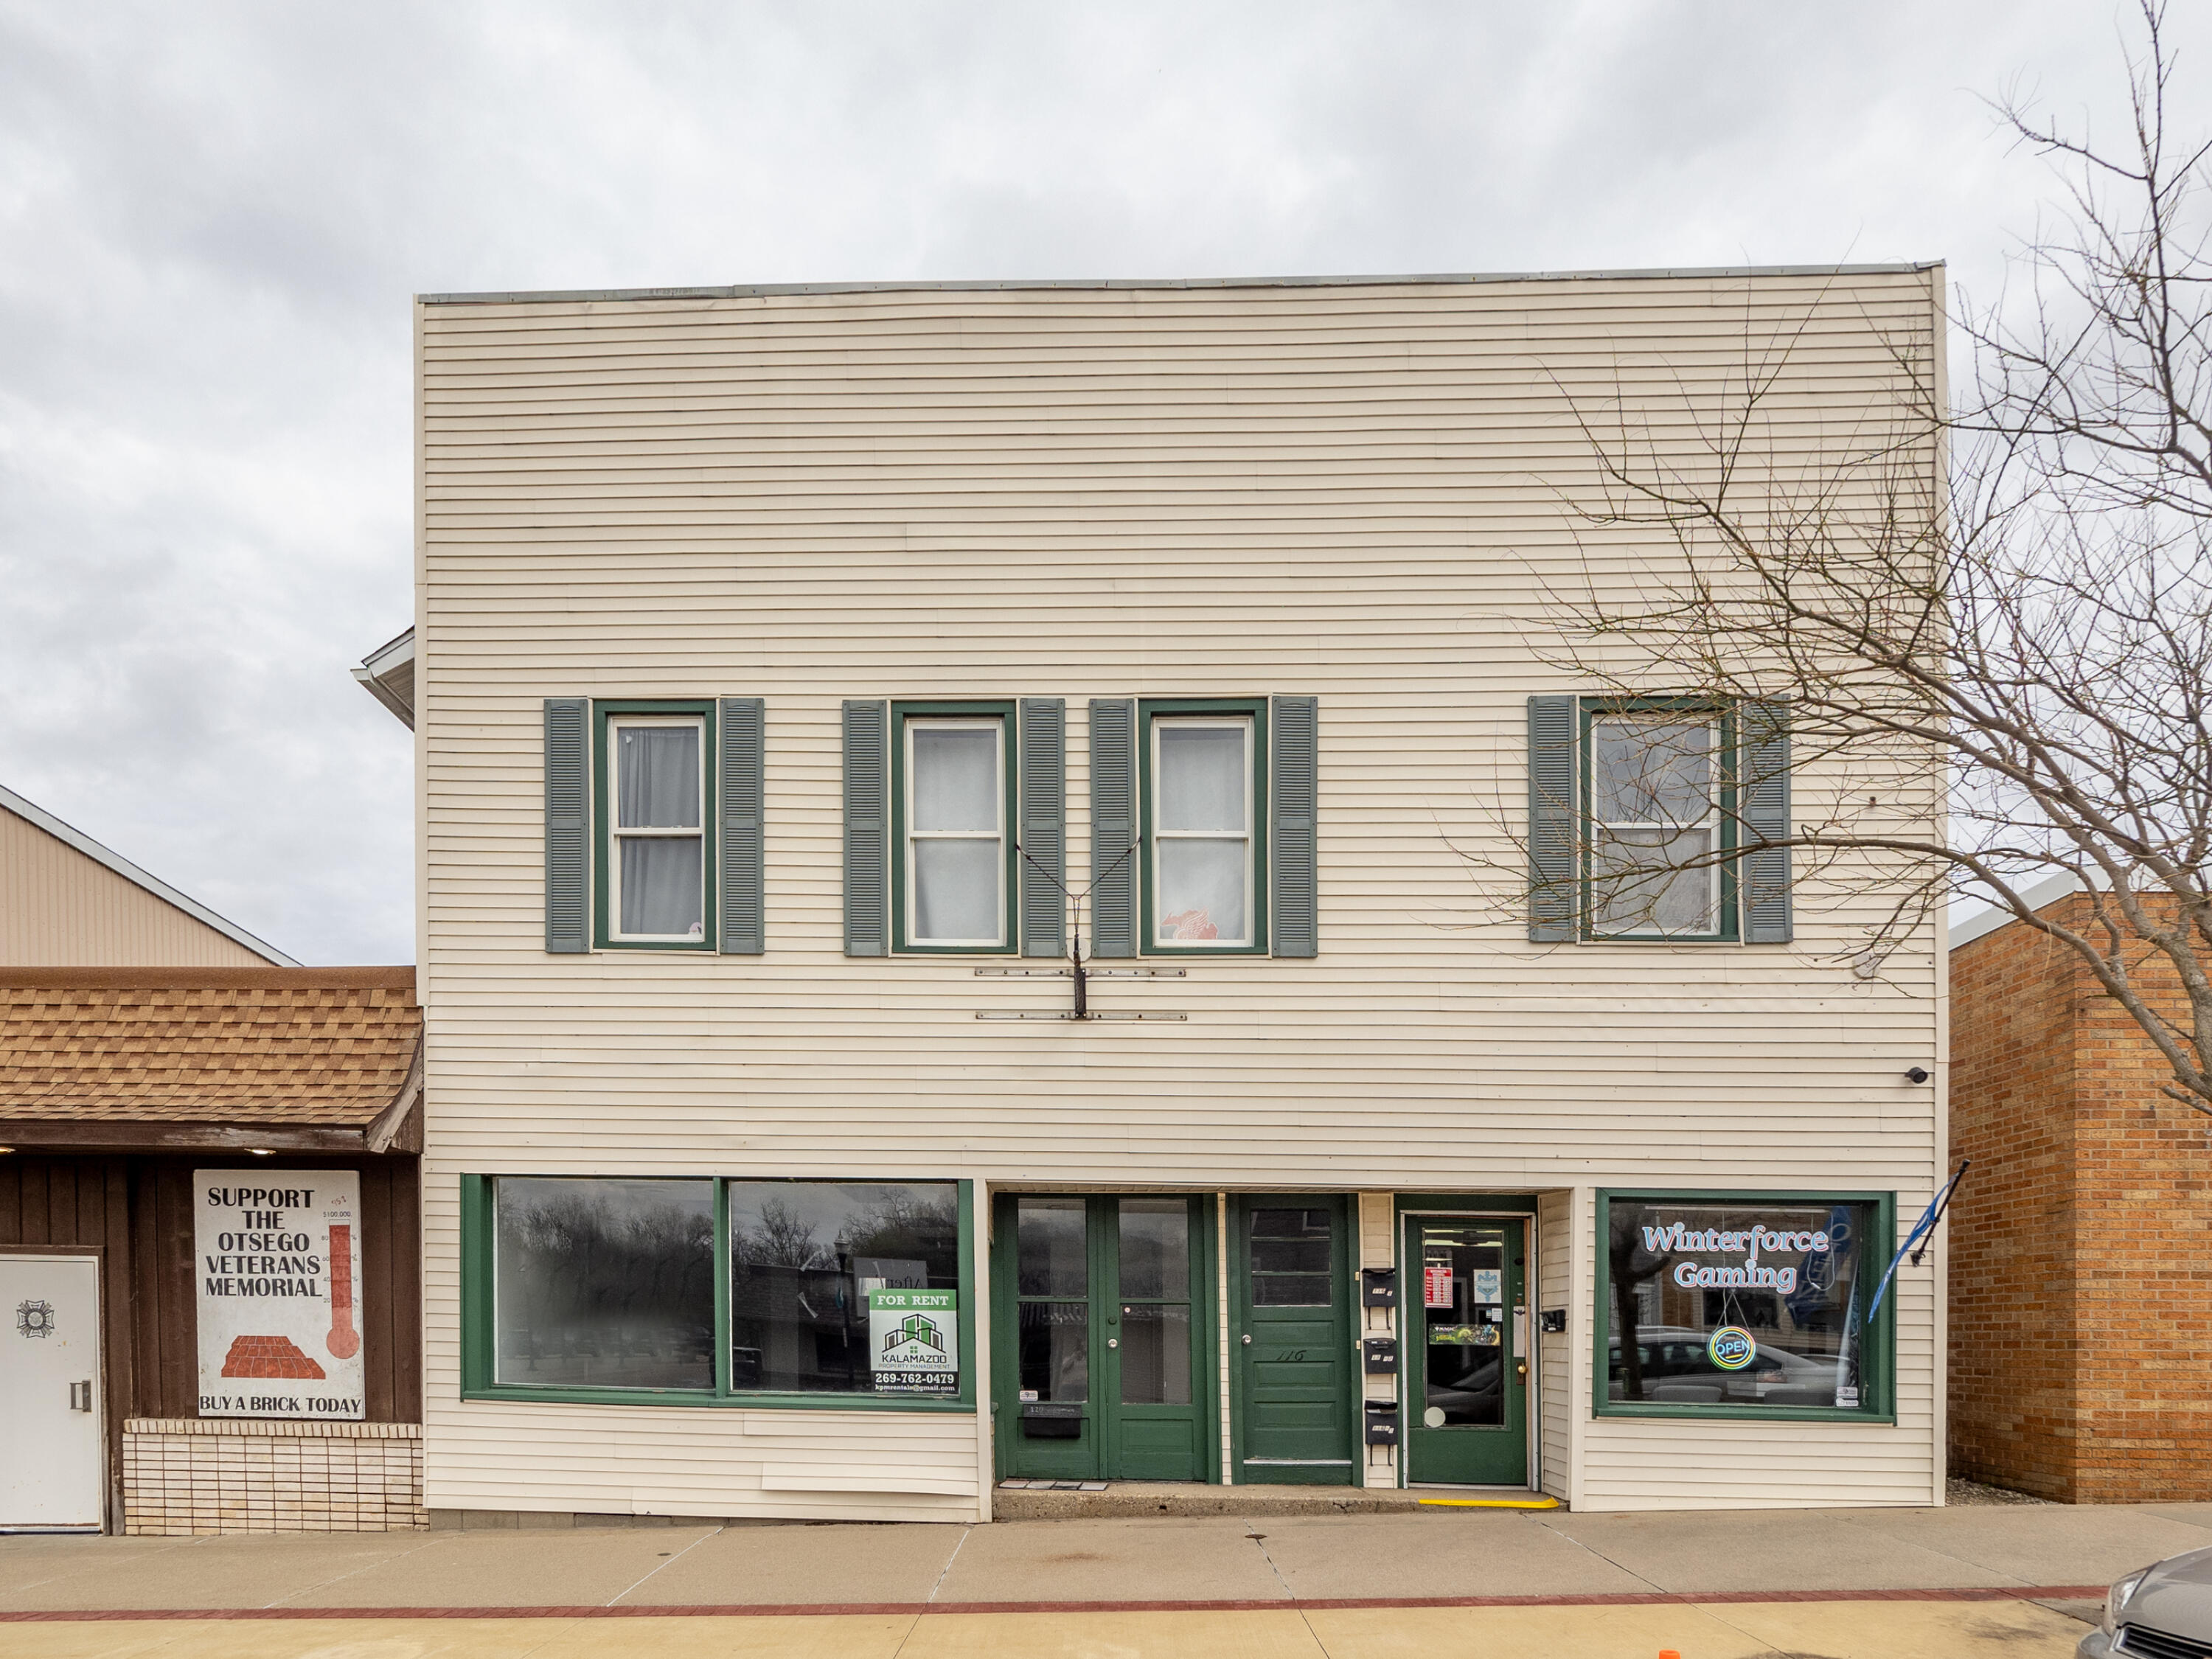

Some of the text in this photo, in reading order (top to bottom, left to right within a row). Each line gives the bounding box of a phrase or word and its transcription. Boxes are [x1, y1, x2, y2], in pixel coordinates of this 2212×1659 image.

[208, 1187, 315, 1208] SUPPORT
[242, 1211, 285, 1229] THE
[218, 1232, 310, 1252] OTSEGO
[1642, 1221, 1829, 1259] Winterforce
[206, 1255, 321, 1275] VETERANS
[1674, 1259, 1797, 1294] Gaming
[206, 1277, 323, 1297] MEMORIAL
[877, 1295, 949, 1306] FOR RENT
[1276, 1349, 1307, 1361] 116
[1715, 1338, 1750, 1357] OPEN
[882, 1354, 947, 1363] KALAMAZOO
[875, 1373, 955, 1384] 269-762-0479
[875, 1384, 955, 1392] kpmrentals@gmail.com
[200, 1396, 361, 1413] BUY A BRICK TODAY
